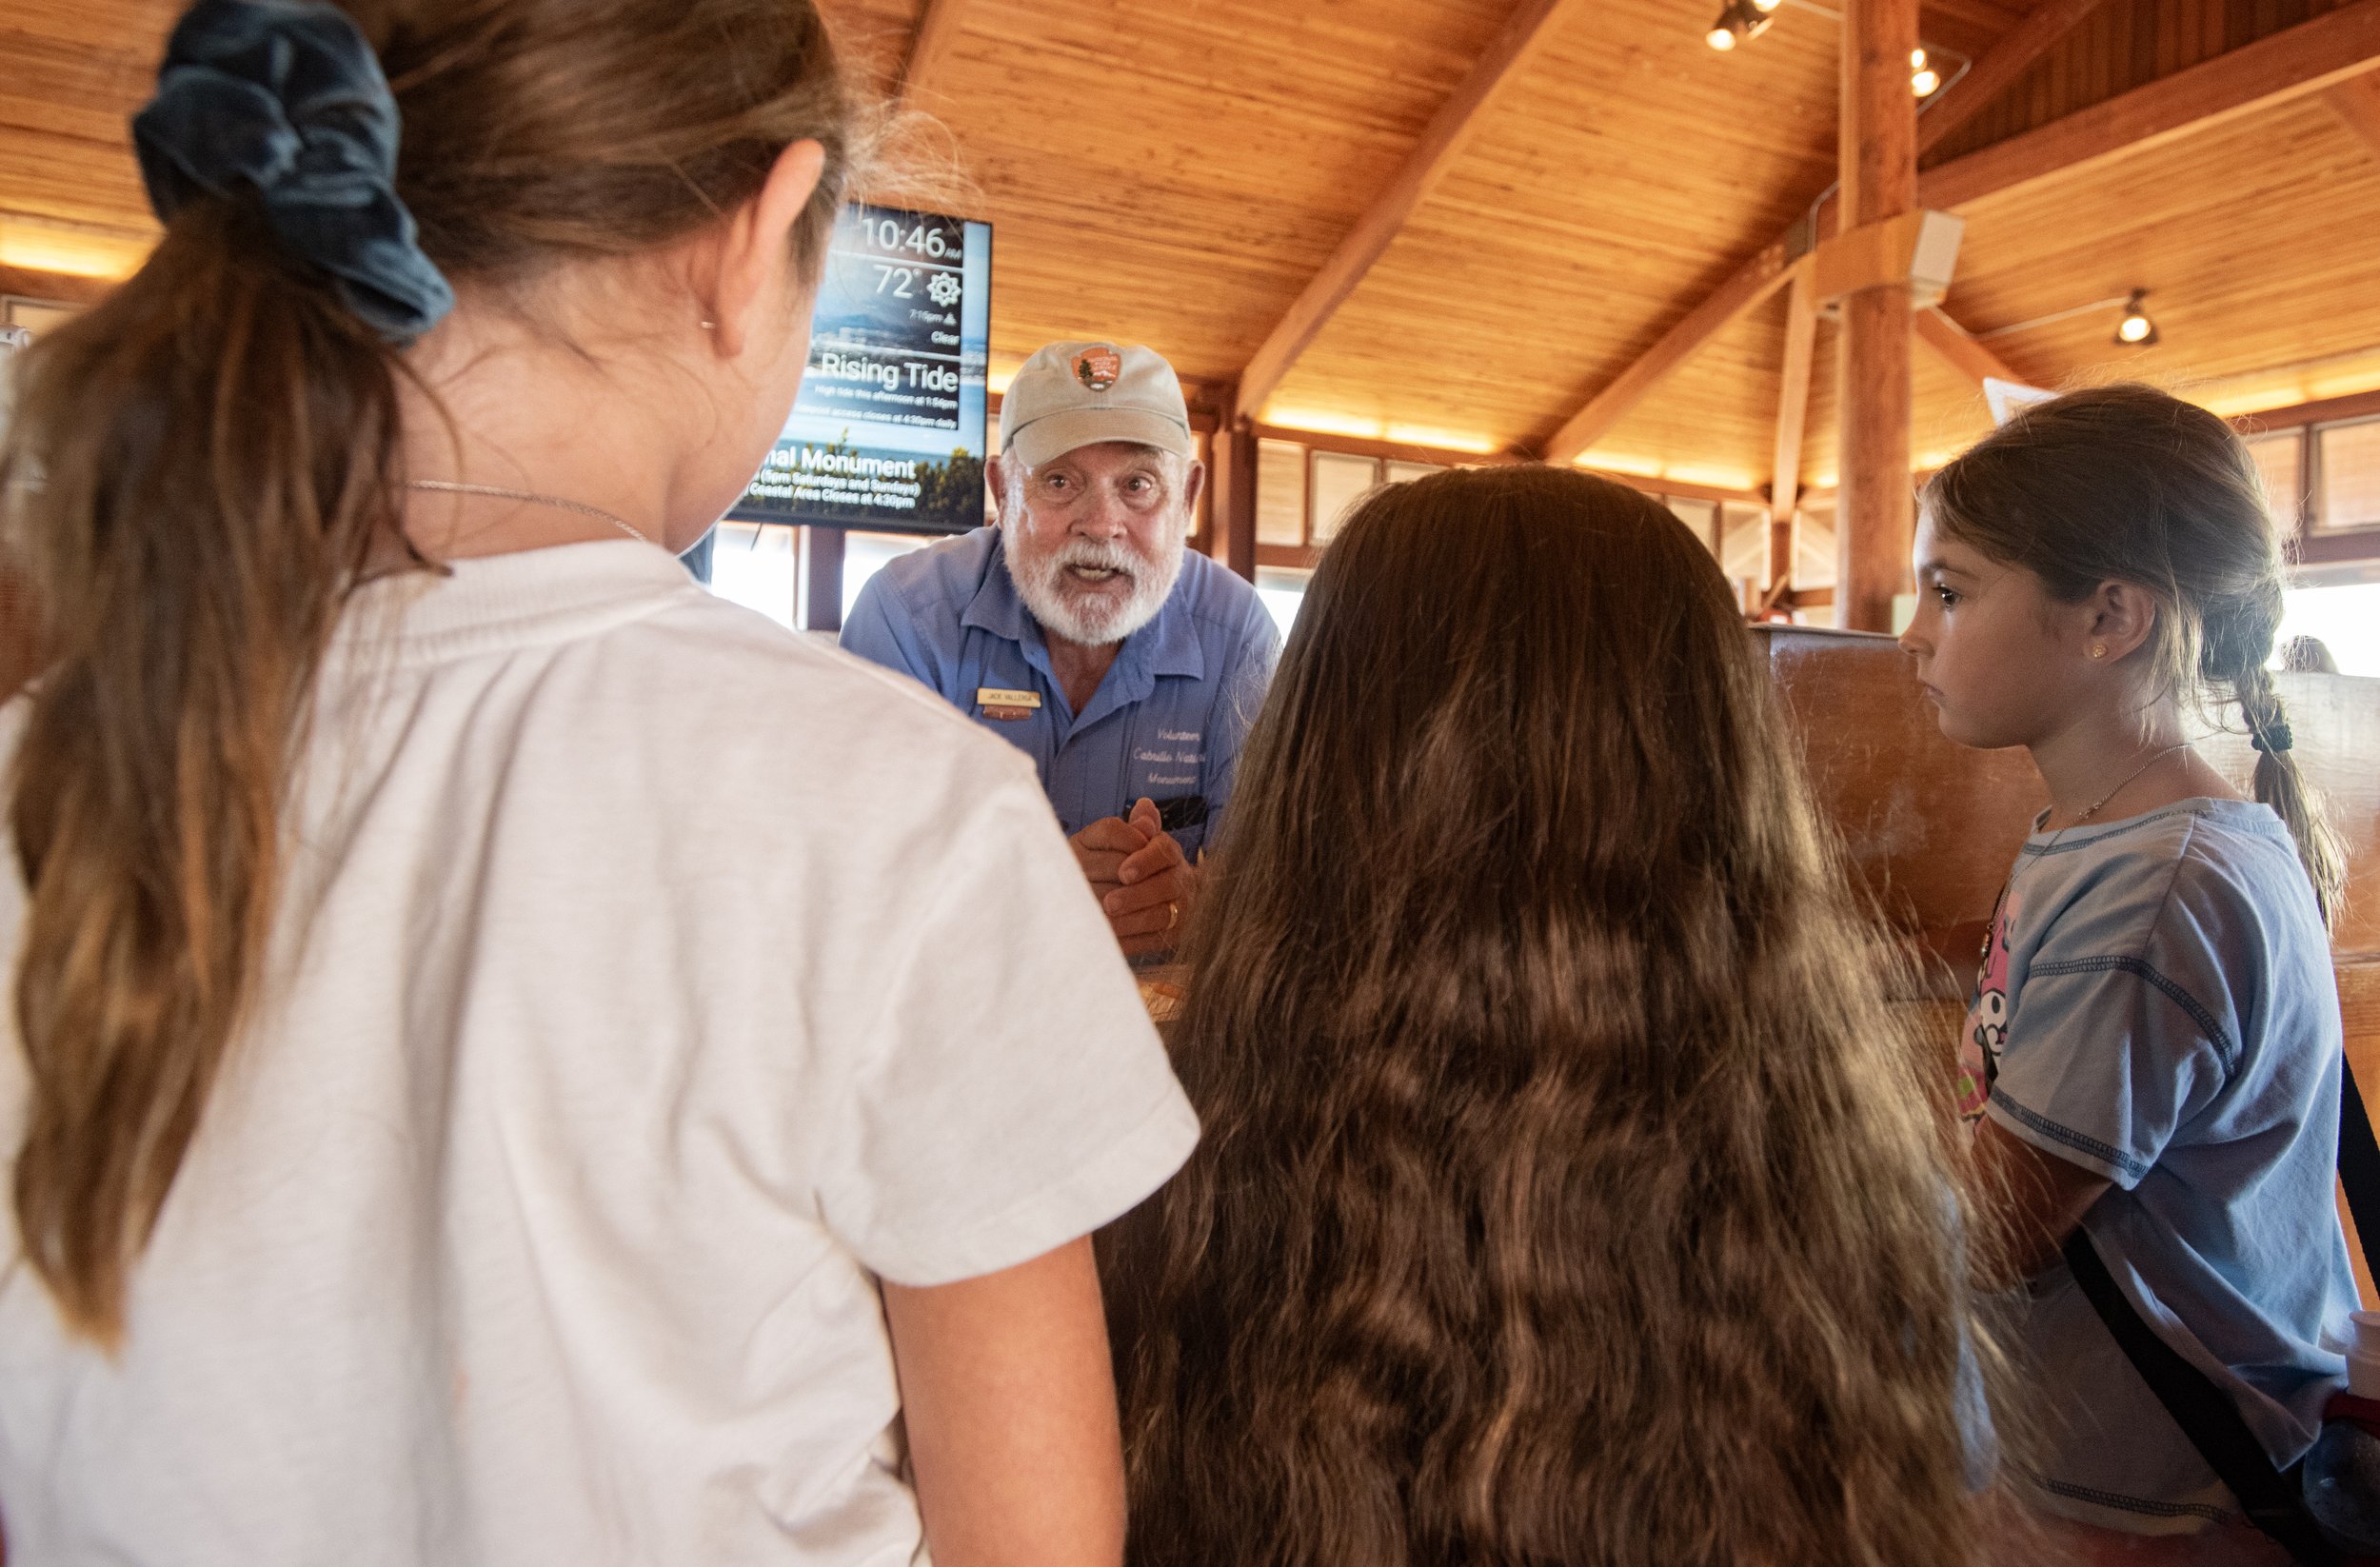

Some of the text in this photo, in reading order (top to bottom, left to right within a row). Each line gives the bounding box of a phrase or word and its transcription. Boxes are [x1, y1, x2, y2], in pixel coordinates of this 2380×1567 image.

[862, 218, 946, 258] 10:46
[931, 330, 961, 347] Clear
[822, 352, 959, 393] Rising Tide
[837, 387, 854, 398] tide
[855, 387, 872, 400] this
[872, 390, 915, 406] afternoon
[915, 396, 926, 407] at
[802, 447, 917, 480] Monument
[750, 482, 794, 500] Coastal
[793, 486, 822, 502] Area
[822, 488, 861, 505] Closes
[860, 492, 874, 506] at
[792, 472, 848, 491] Saturdays
[848, 478, 870, 491] and
[870, 479, 922, 499] Sundays)
